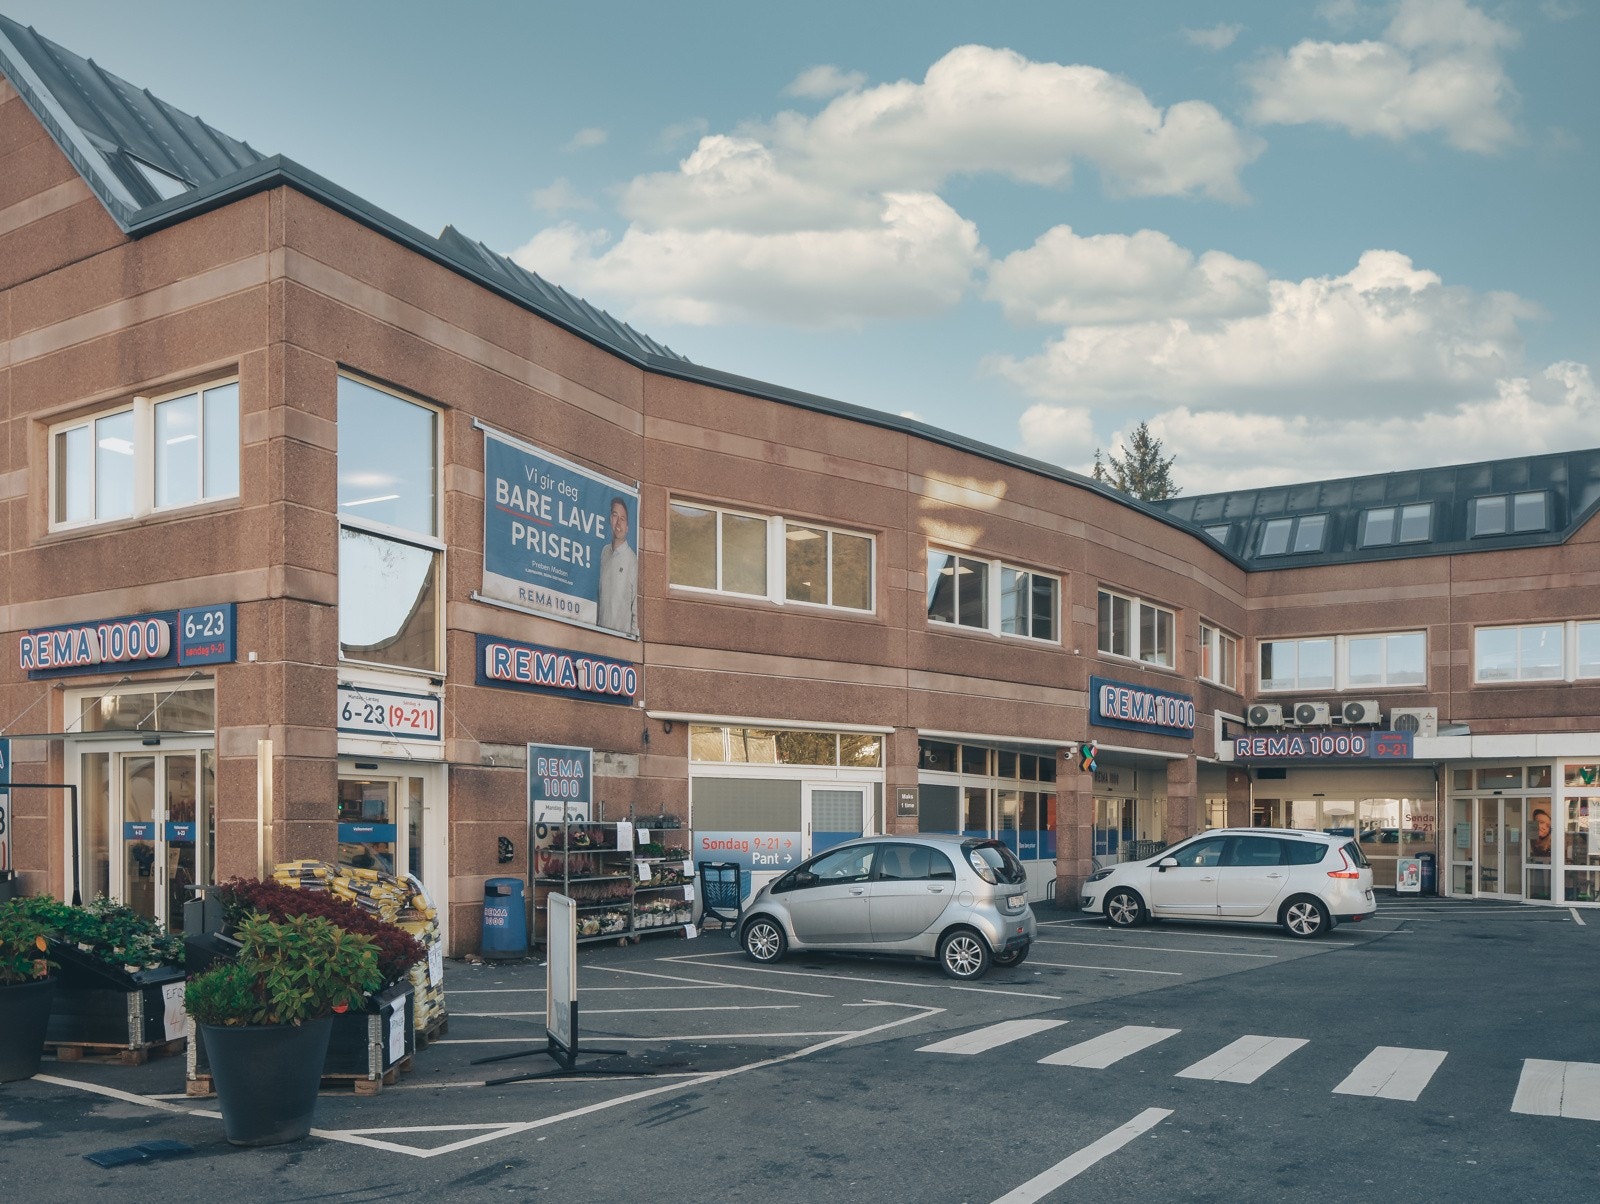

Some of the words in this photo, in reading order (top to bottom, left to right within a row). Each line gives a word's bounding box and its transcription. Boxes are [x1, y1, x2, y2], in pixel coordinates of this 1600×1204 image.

[524, 465, 538, 484] Vi
[541, 474, 555, 491] gir
[557, 479, 579, 502] deg
[495, 477, 552, 521] BARE
[558, 501, 605, 539] LAVE
[511, 521, 591, 569] PRISER!
[518, 587, 552, 607] REMA
[555, 597, 580, 614] 1000
[185, 611, 225, 639] 6-23
[19, 627, 93, 670] REMA
[97, 618, 161, 662] 1000
[210, 642, 225, 654] 9-21
[491, 643, 577, 689] REMA
[579, 658, 638, 697] 1000
[341, 701, 385, 725] 6-23
[388, 704, 435, 731] (9-21)
[1103, 684, 1157, 725] REMA
[1159, 695, 1196, 730] 1000
[1235, 737, 1306, 757] REMA
[1308, 735, 1366, 756] 1000
[1377, 743, 1408, 756] 9-21
[537, 757, 584, 779] REMA
[543, 778, 580, 798] 1000
[1405, 813, 1435, 822] Sønda
[1413, 823, 1433, 832] 9-21
[702, 837, 749, 853] Søndag
[753, 837, 779, 850] 9-21
[752, 852, 780, 865] Pant
